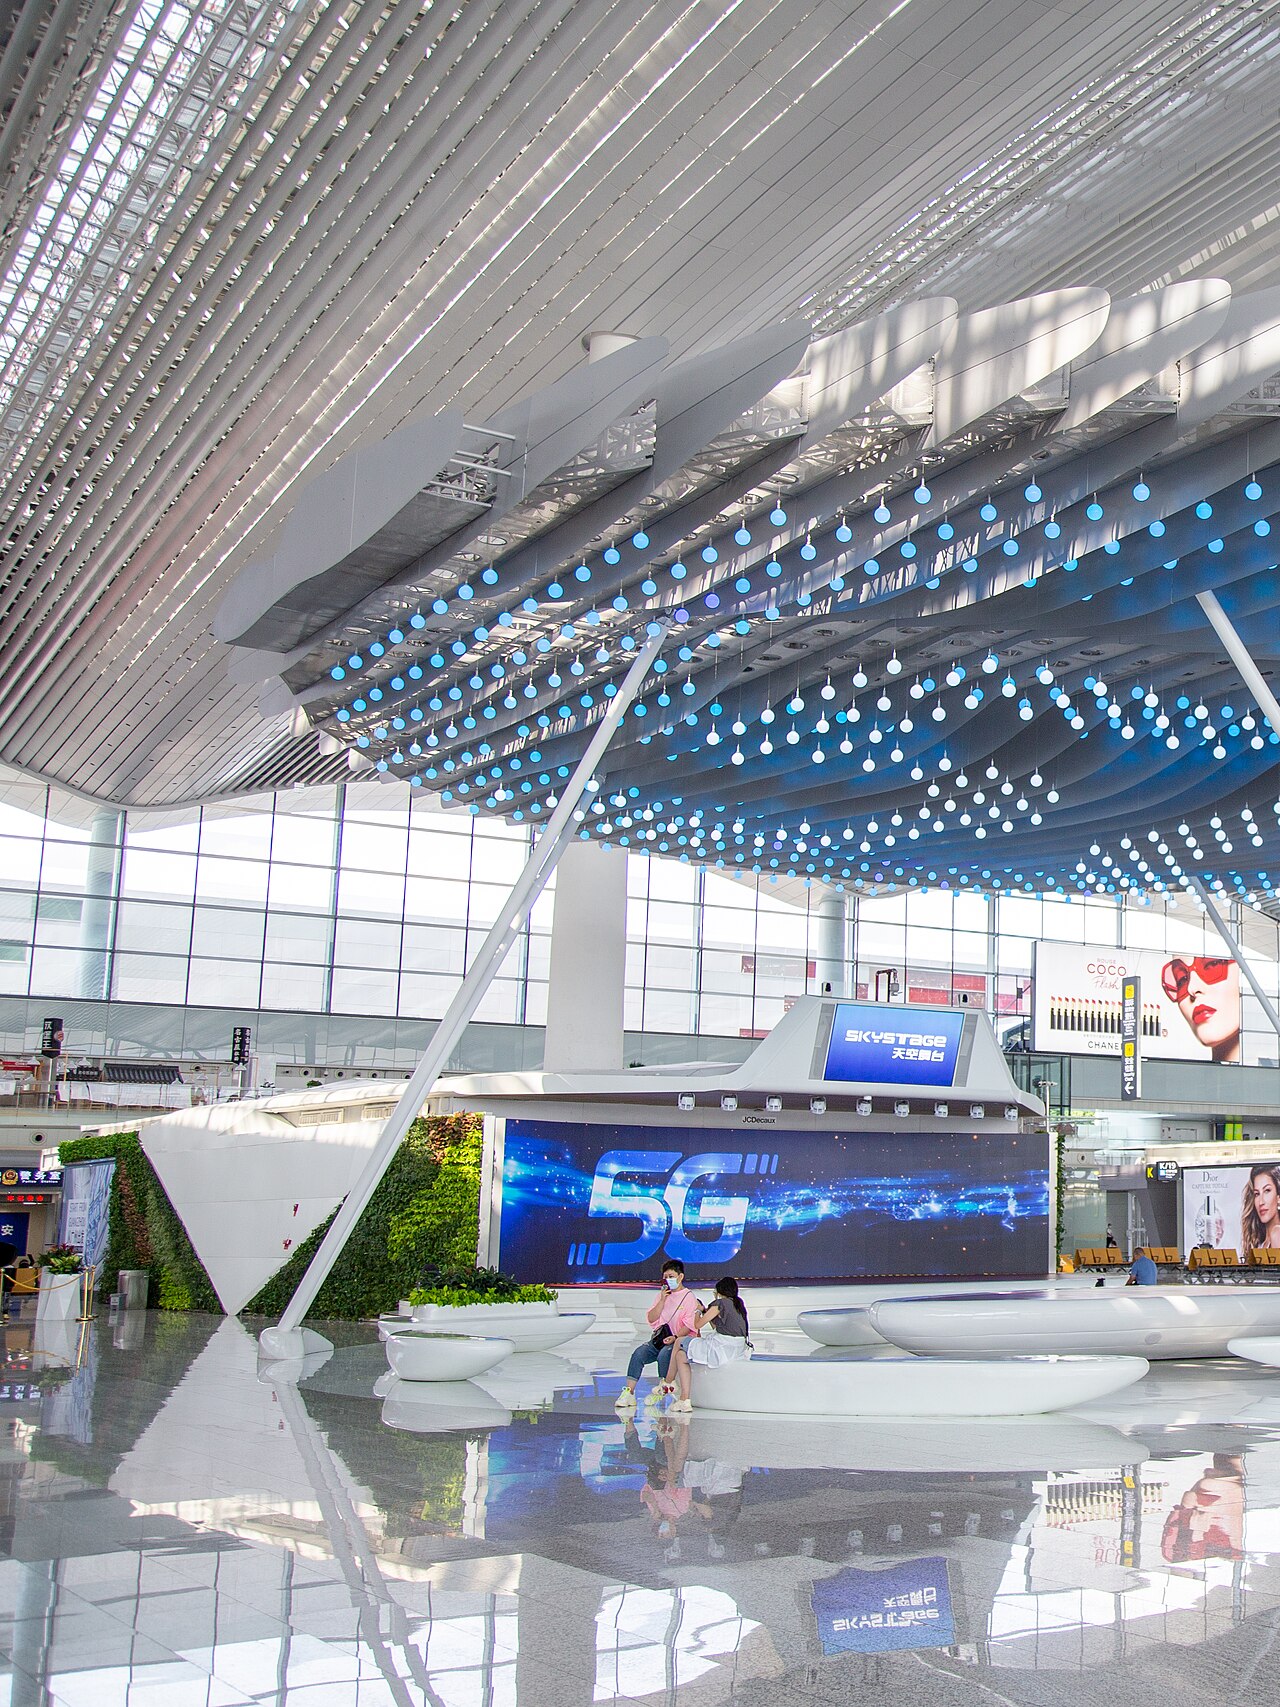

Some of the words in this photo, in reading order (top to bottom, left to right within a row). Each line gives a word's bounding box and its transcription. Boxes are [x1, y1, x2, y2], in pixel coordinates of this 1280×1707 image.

[1087, 963, 1127, 976] COCO
[43, 1021, 52, 1048] 汉堡王
[1088, 1041, 1120, 1050] CHANE
[1159, 1162, 1176, 1170] K/19
[20, 1170, 61, 1180] 警务室
[1147, 1167, 1154, 1178] K
[1203, 1171, 1218, 1182] Dior
[588, 1150, 750, 1264] 5G
